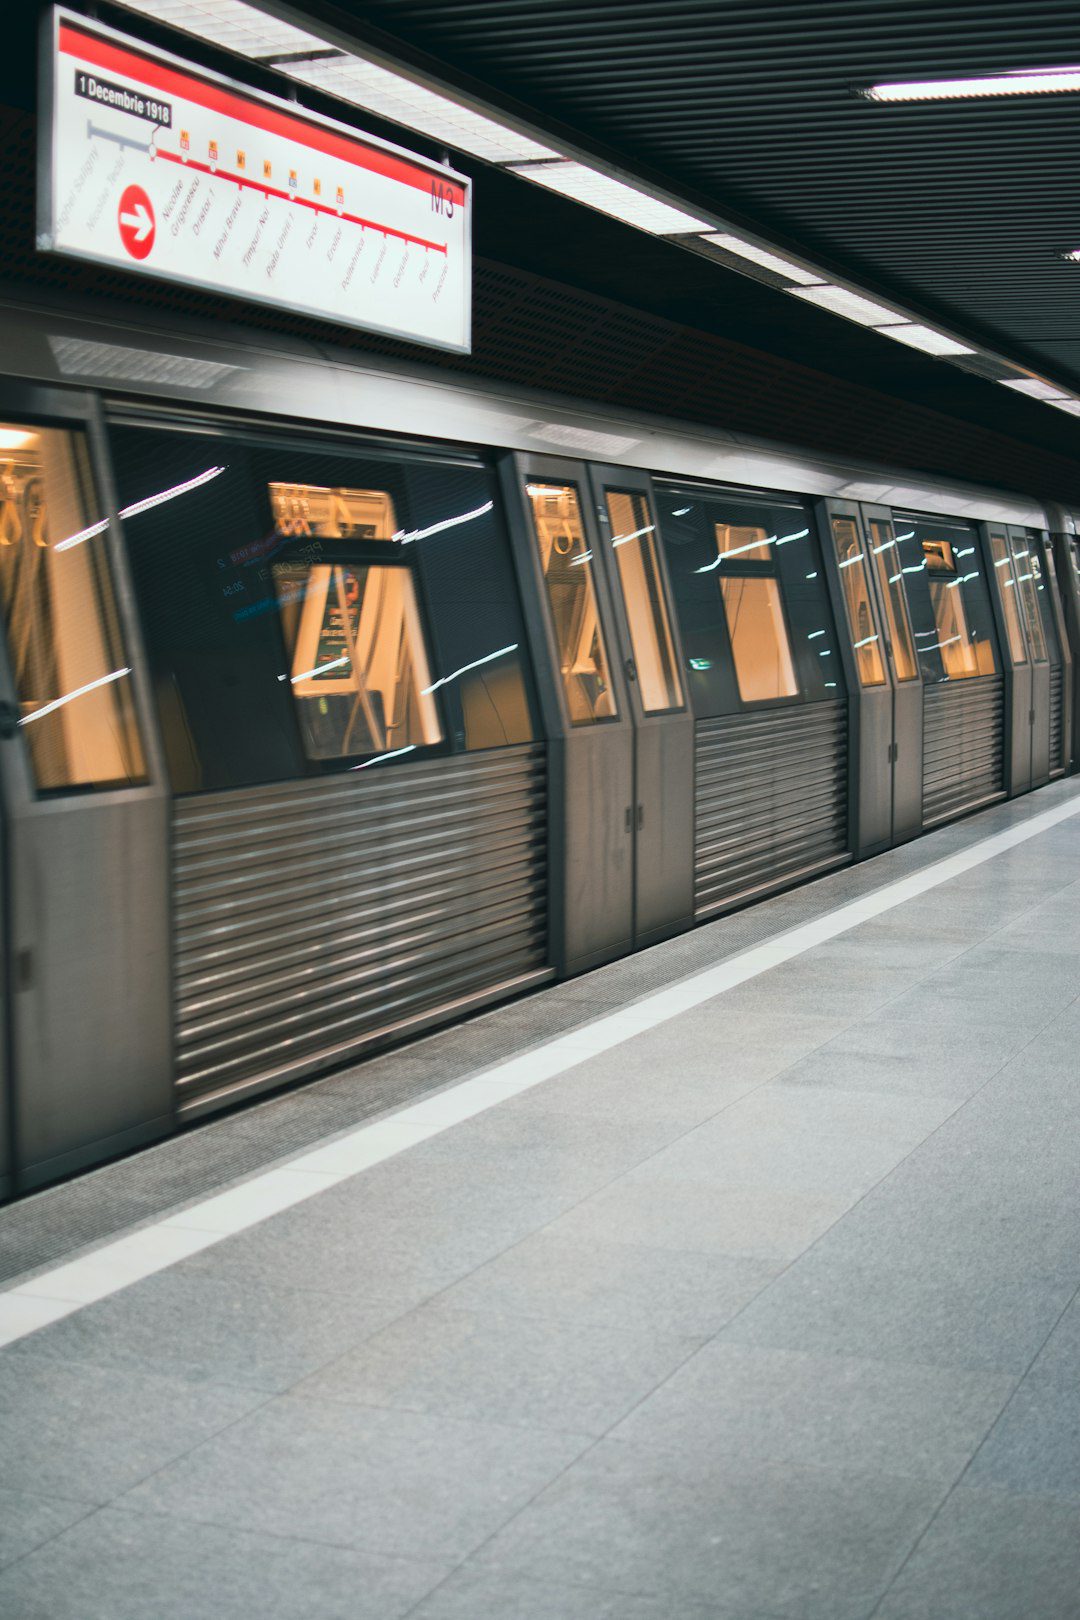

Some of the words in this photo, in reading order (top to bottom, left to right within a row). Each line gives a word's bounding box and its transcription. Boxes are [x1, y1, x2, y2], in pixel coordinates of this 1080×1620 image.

[79, 76, 86, 92] 1
[88, 78, 144, 114] Decembrie
[145, 101, 170, 123] 1918
[162, 179, 184, 222] Nicolae
[171, 175, 201, 237] Grigorescu
[192, 198, 211, 237] Dristor
[430, 179, 454, 219] M3
[213, 229, 229, 261] Mihai
[225, 195, 242, 230] Bravu
[242, 225, 262, 267] Timpuri
